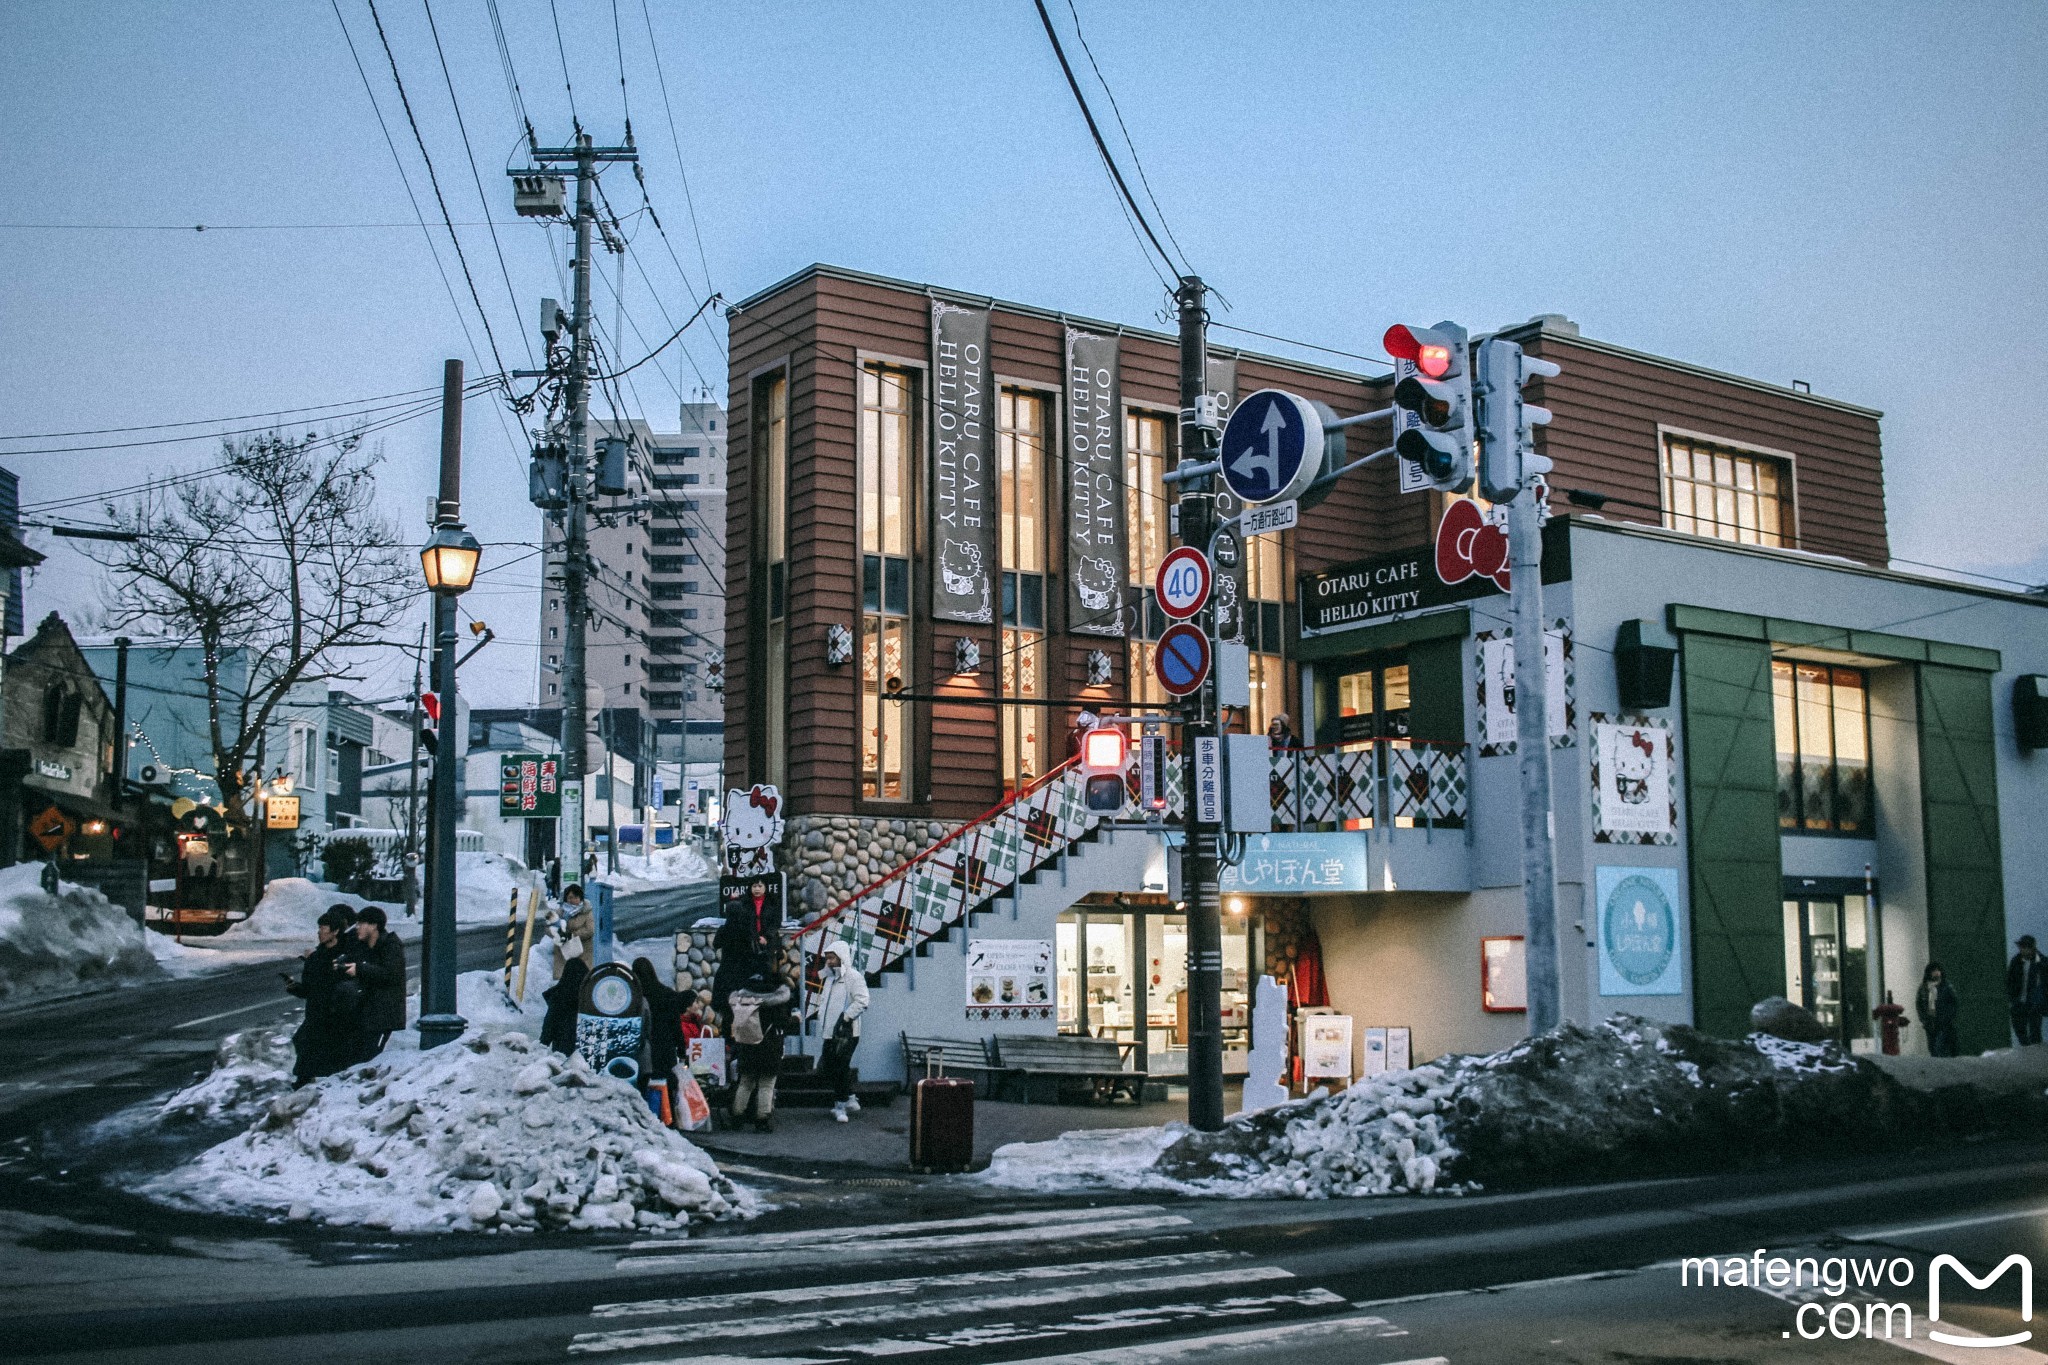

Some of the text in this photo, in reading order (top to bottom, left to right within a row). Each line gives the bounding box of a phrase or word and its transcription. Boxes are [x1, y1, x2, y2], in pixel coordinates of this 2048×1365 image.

[939, 340, 957, 528] HELLO KITTY
[963, 344, 981, 528] OTARU CAFE
[1073, 365, 1091, 545] HELLO KITTY
[1095, 368, 1114, 545] OTARU CAFE
[1244, 505, 1293, 531] 一方通行路出口
[1168, 566, 1198, 599] 40
[1318, 561, 1419, 596] OTARU CAFE
[1320, 590, 1420, 624] HELLO KITTY
[521, 761, 538, 810] 海鮮丼
[541, 761, 557, 793] 寿司
[1201, 740, 1215, 820] 歩車分離信号
[1029, 810, 1040, 821] KT
[1006, 858, 1016, 868] KT
[722, 885, 749, 896] OTAR
[882, 903, 893, 916] KT
[932, 904, 943, 916] KT
